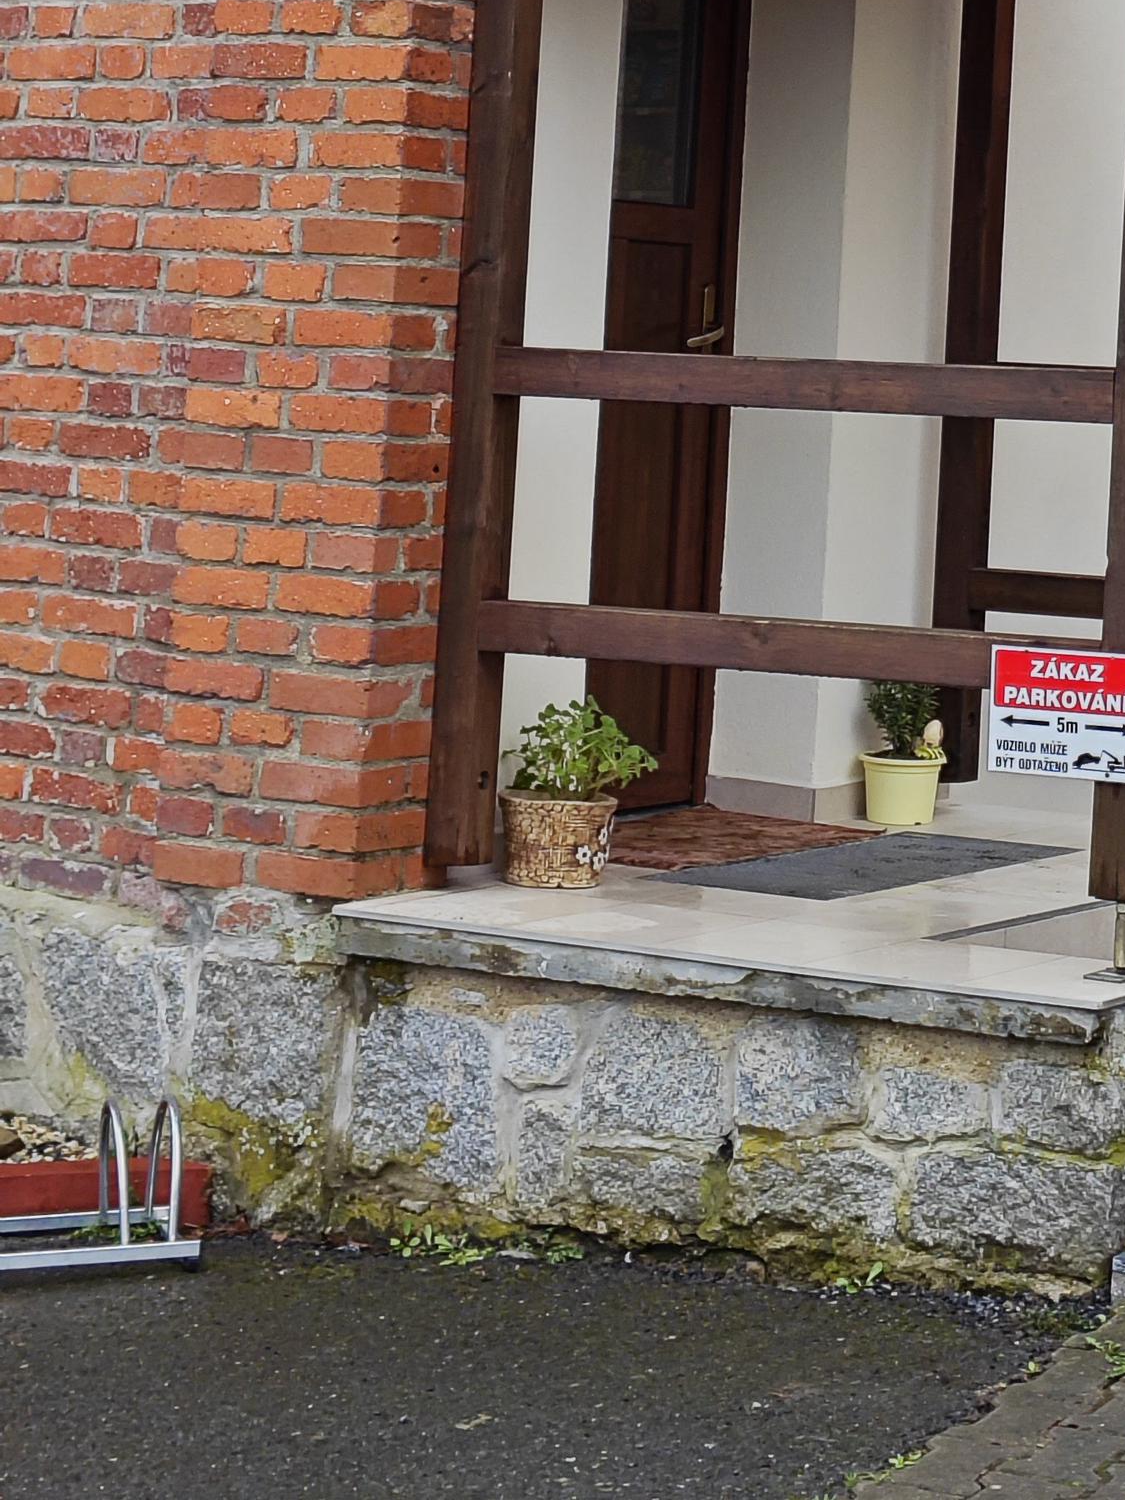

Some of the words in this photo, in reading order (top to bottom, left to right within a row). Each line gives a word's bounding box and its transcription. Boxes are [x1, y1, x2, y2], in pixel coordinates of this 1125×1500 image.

[1030, 658, 1105, 682] ZÁKAZ
[1056, 717, 1078, 734] 5m
[996, 739, 1036, 753] VOZIDLO
[1040, 740, 1067, 756] MŮŽE
[995, 754, 1014, 769] BÝT
